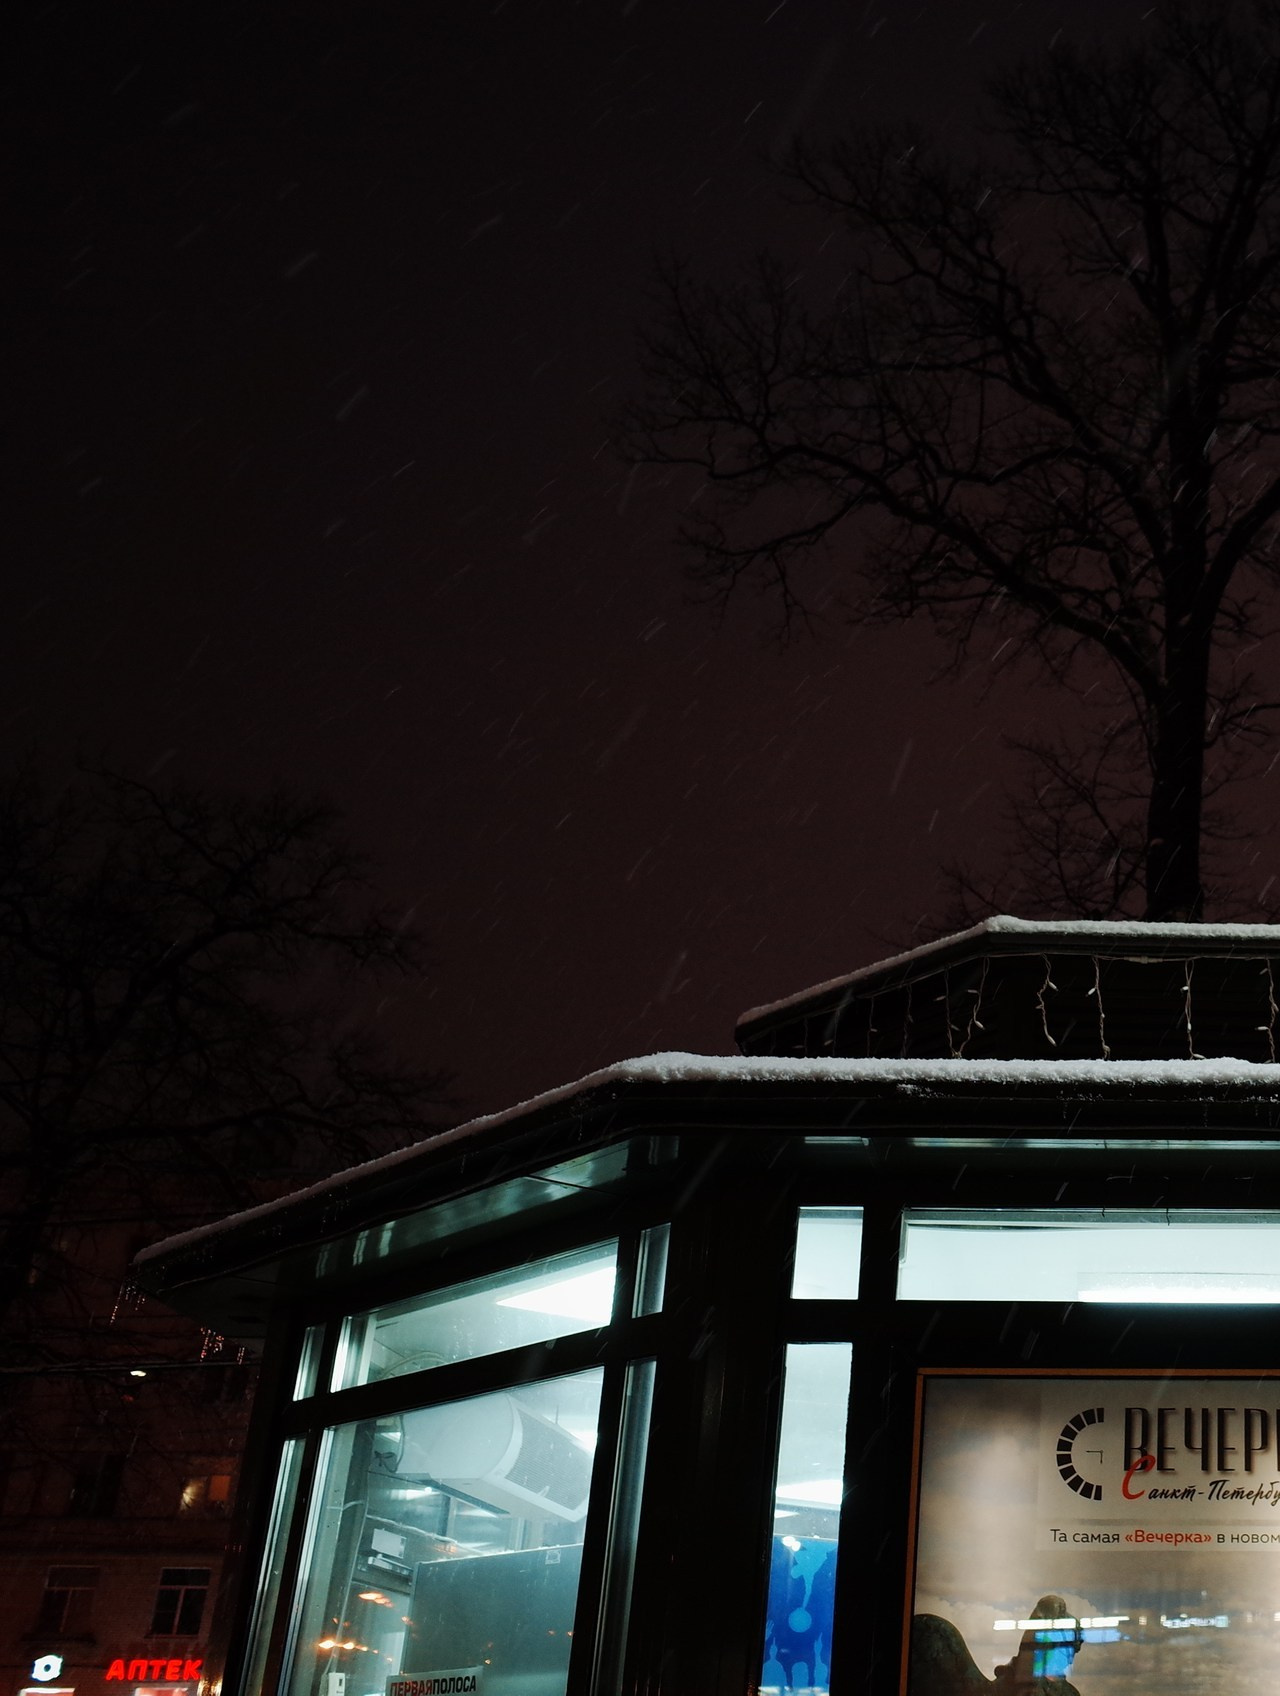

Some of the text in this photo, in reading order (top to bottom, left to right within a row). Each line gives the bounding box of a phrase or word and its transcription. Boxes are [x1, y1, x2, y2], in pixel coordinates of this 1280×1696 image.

[1050, 1528, 1068, 1544] Та
[1072, 1532, 1120, 1544] самая
[1124, 1529, 1212, 1547] «Вечерка»
[1216, 1533, 1226, 1544] в
[1230, 1533, 1280, 1544] новом
